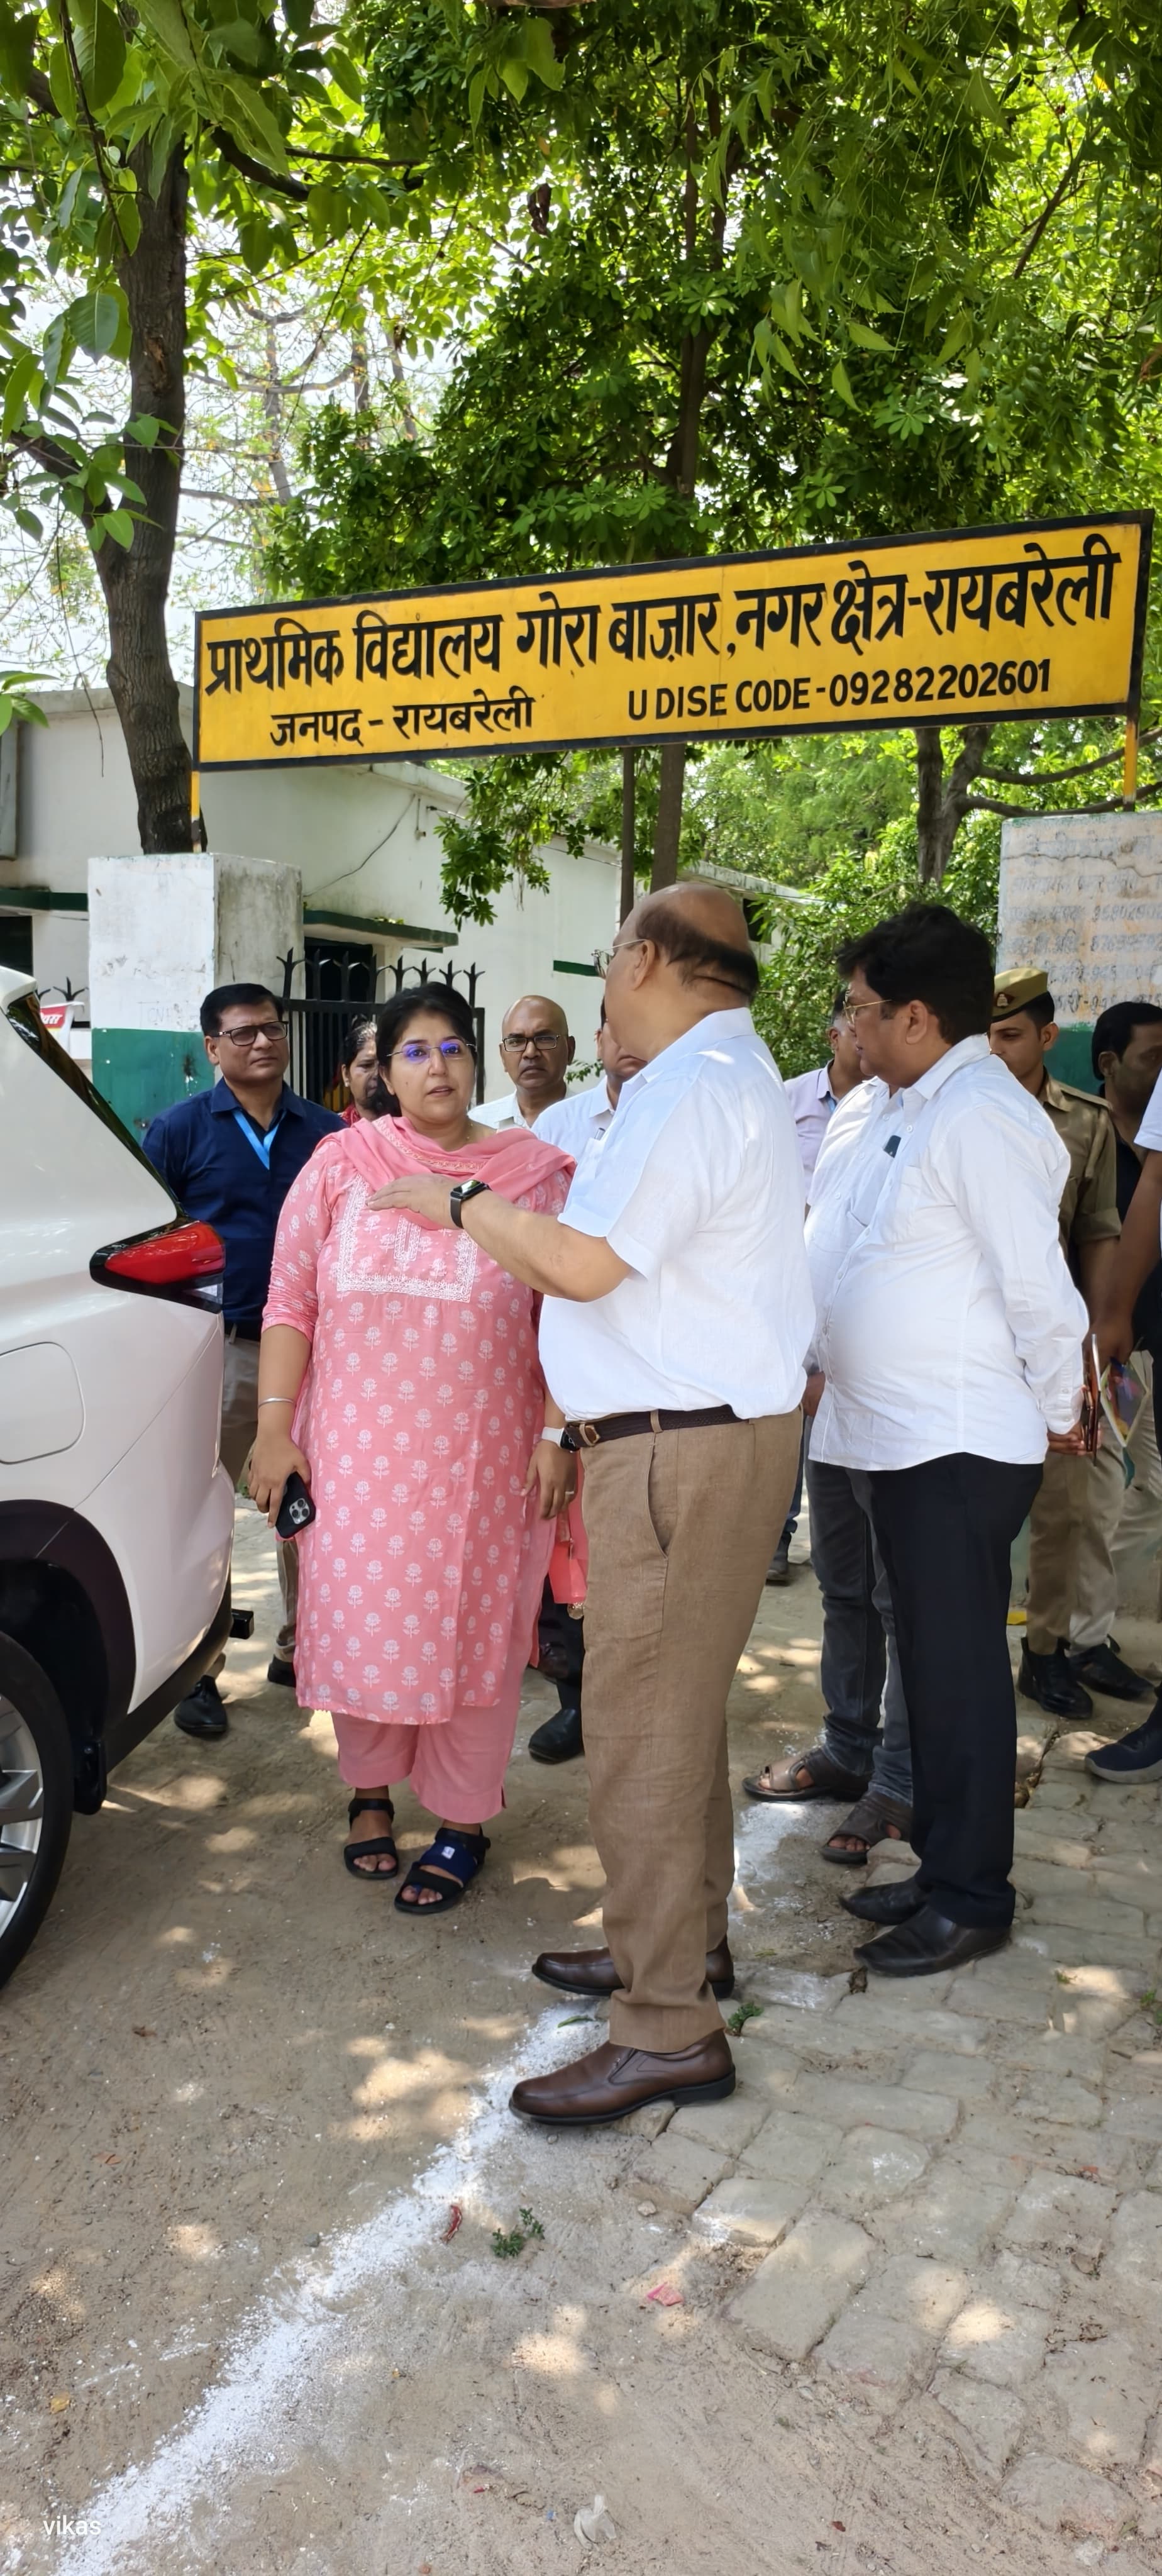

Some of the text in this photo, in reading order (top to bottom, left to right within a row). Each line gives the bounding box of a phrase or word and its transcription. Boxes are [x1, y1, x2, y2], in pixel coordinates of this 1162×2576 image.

[205, 618, 344, 696] प्राथमिक
[351, 609, 504, 681] विद्यालय
[516, 591, 601, 667] गोरा
[270, 709, 363, 747] जनपद
[392, 685, 536, 739] रायबरेली
